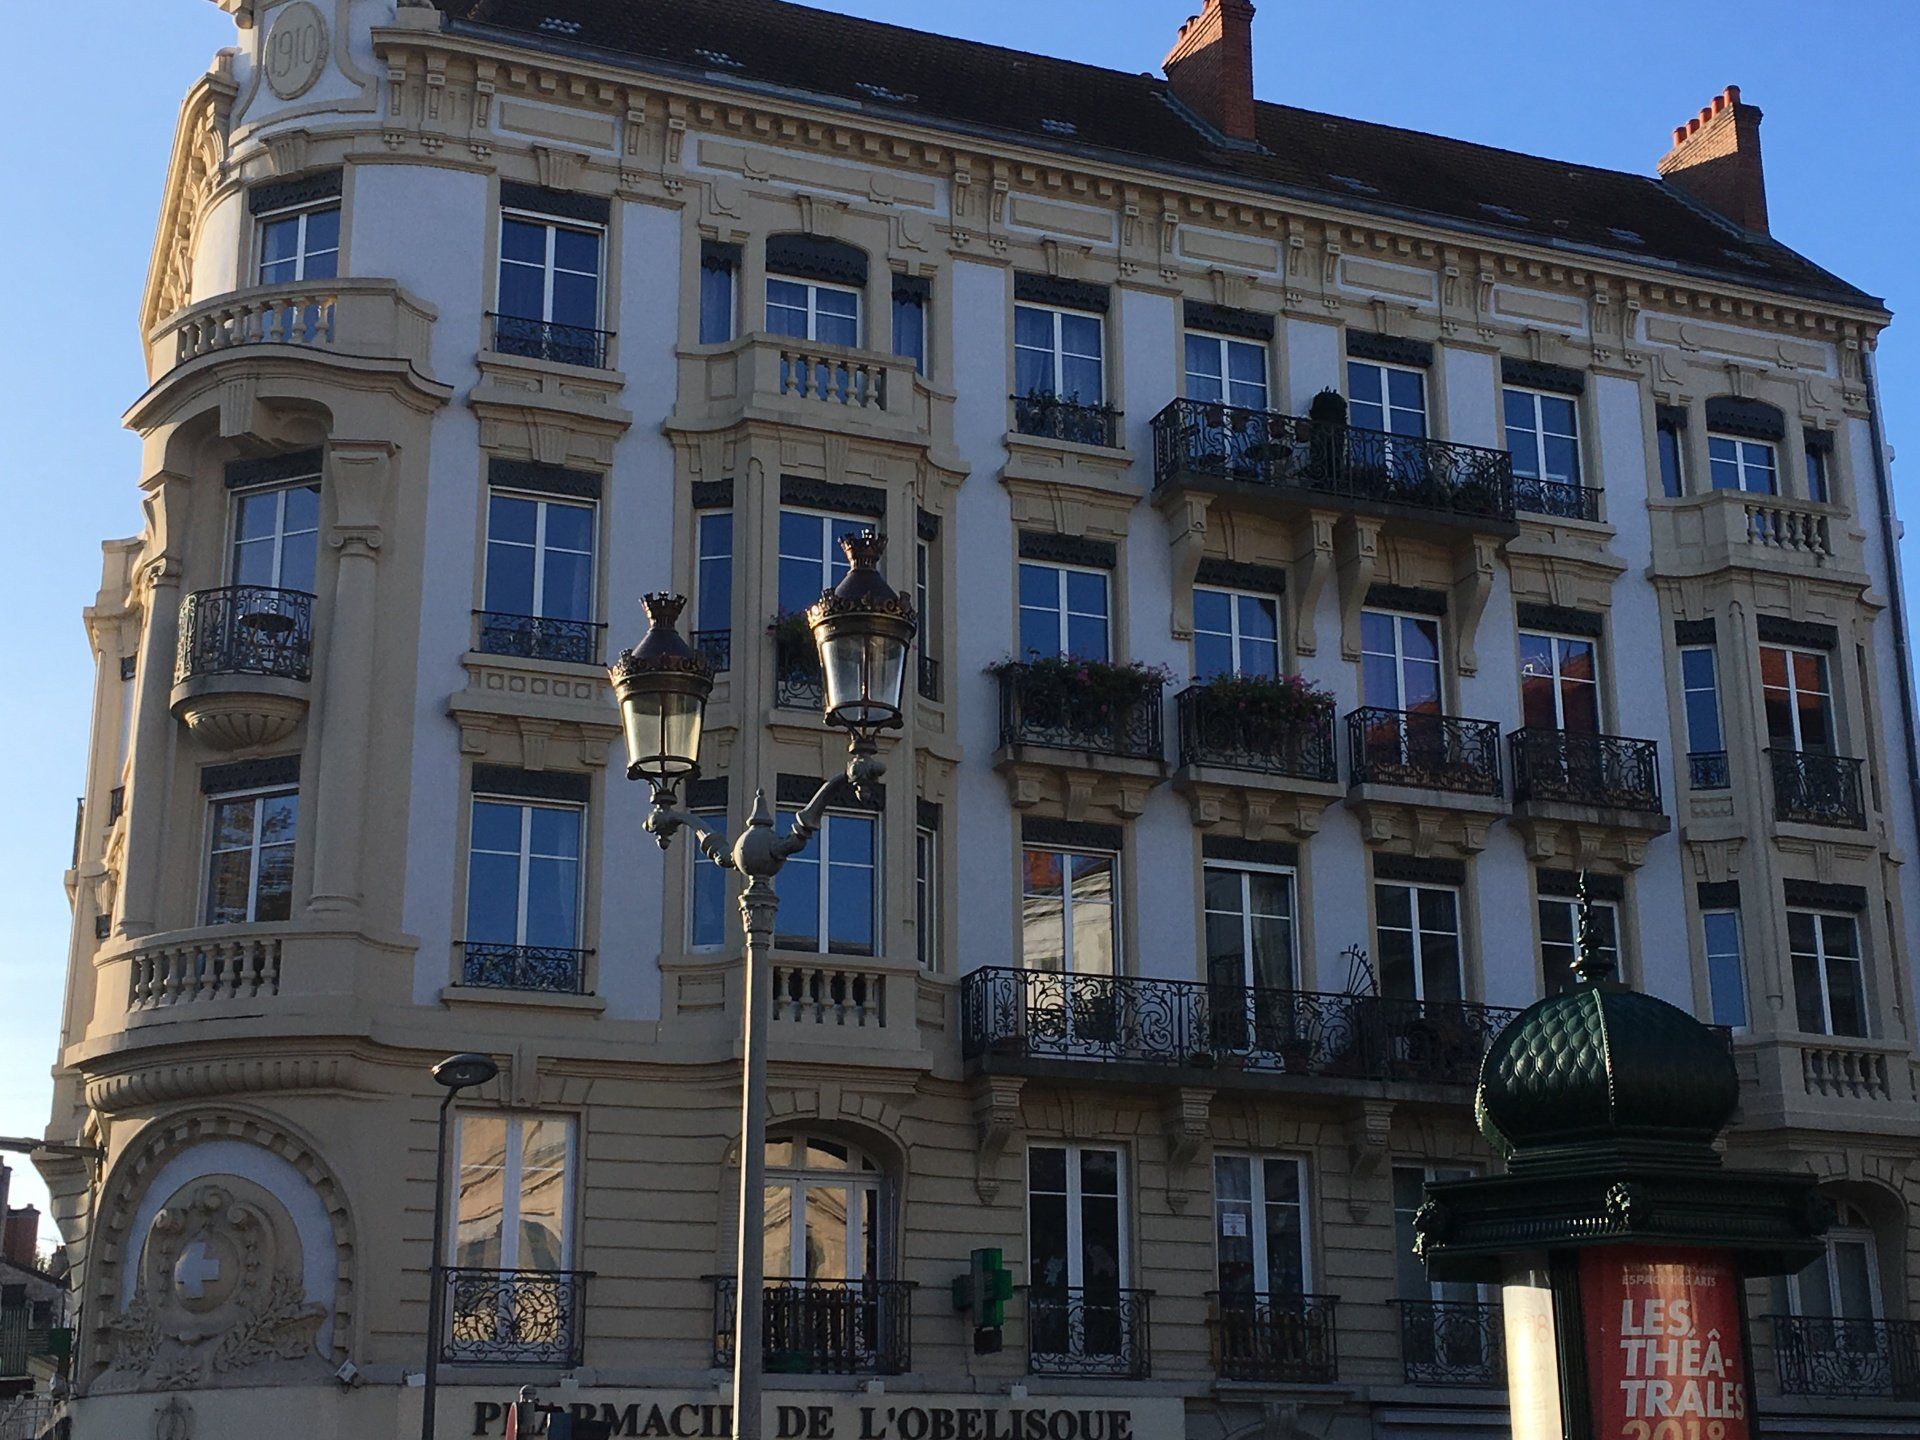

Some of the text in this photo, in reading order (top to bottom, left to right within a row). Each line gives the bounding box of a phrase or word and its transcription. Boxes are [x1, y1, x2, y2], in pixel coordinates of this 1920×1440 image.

[270, 25, 316, 78] 1910
[1621, 1299, 1691, 1336] LES
[1620, 1329, 1733, 1378] THÉÂ-
[1620, 1380, 1745, 1420] TRALES
[776, 1404, 835, 1439] DE
